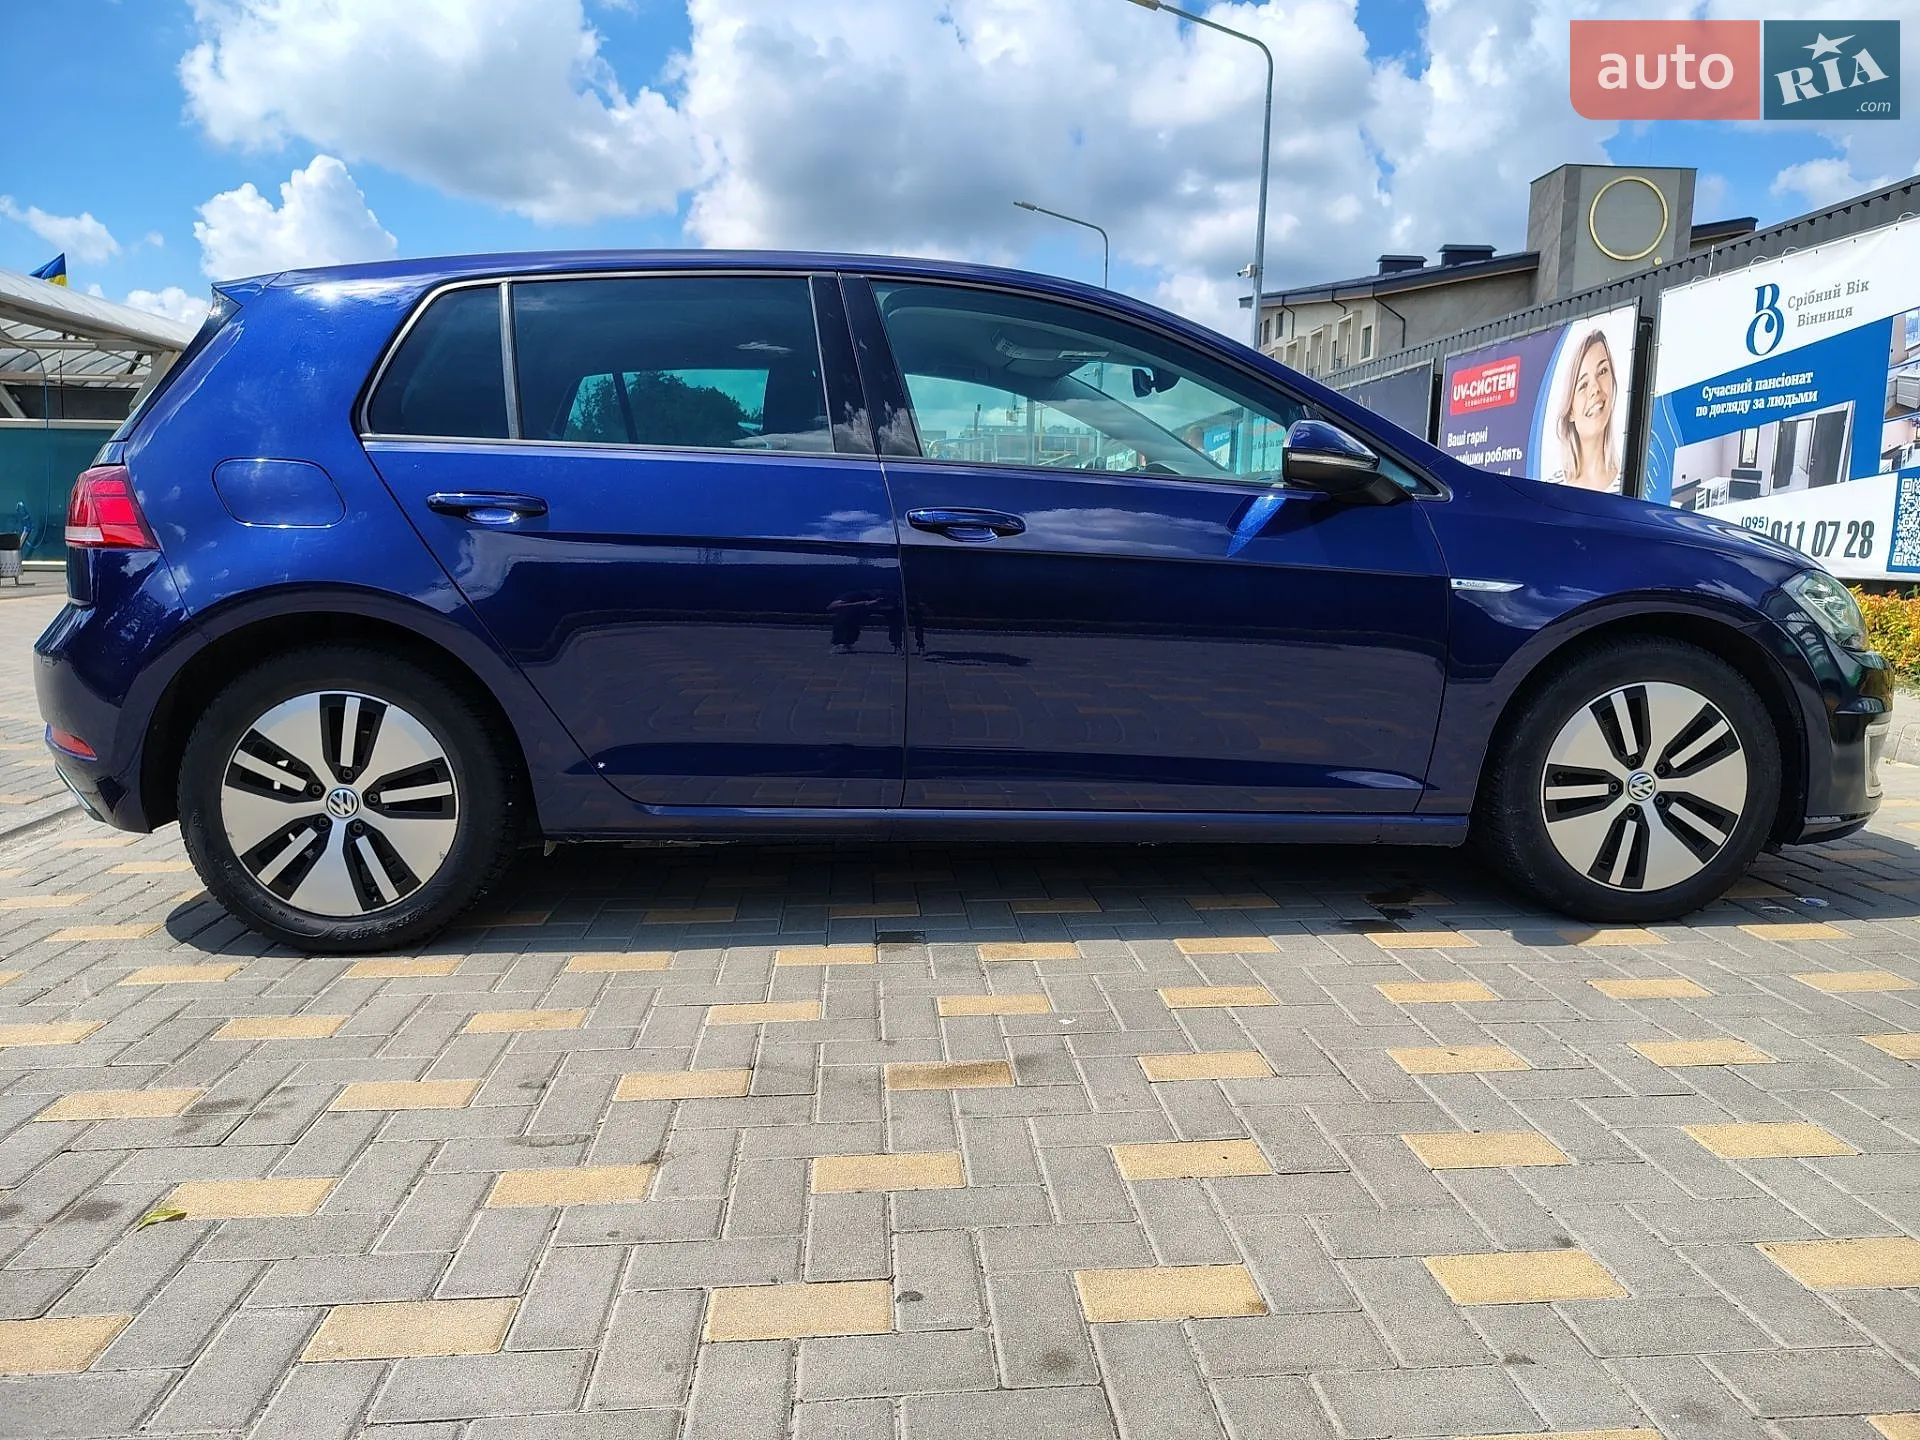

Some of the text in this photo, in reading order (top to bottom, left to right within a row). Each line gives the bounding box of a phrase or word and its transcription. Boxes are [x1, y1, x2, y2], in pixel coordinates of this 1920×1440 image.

[1787, 279, 1869, 311] Срібний Вік
[1797, 306, 1853, 327] Вінниця
[1702, 371, 1813, 401] Сучасний пансіонат
[1696, 390, 1818, 418] по догляду за людьми
[1447, 426, 1488, 447] Ваші гарні
[1485, 447, 1522, 467] роблять
[1741, 516, 1768, 532] (095)
[1811, 520, 1841, 557] 07
[1844, 520, 1875, 559] 28
